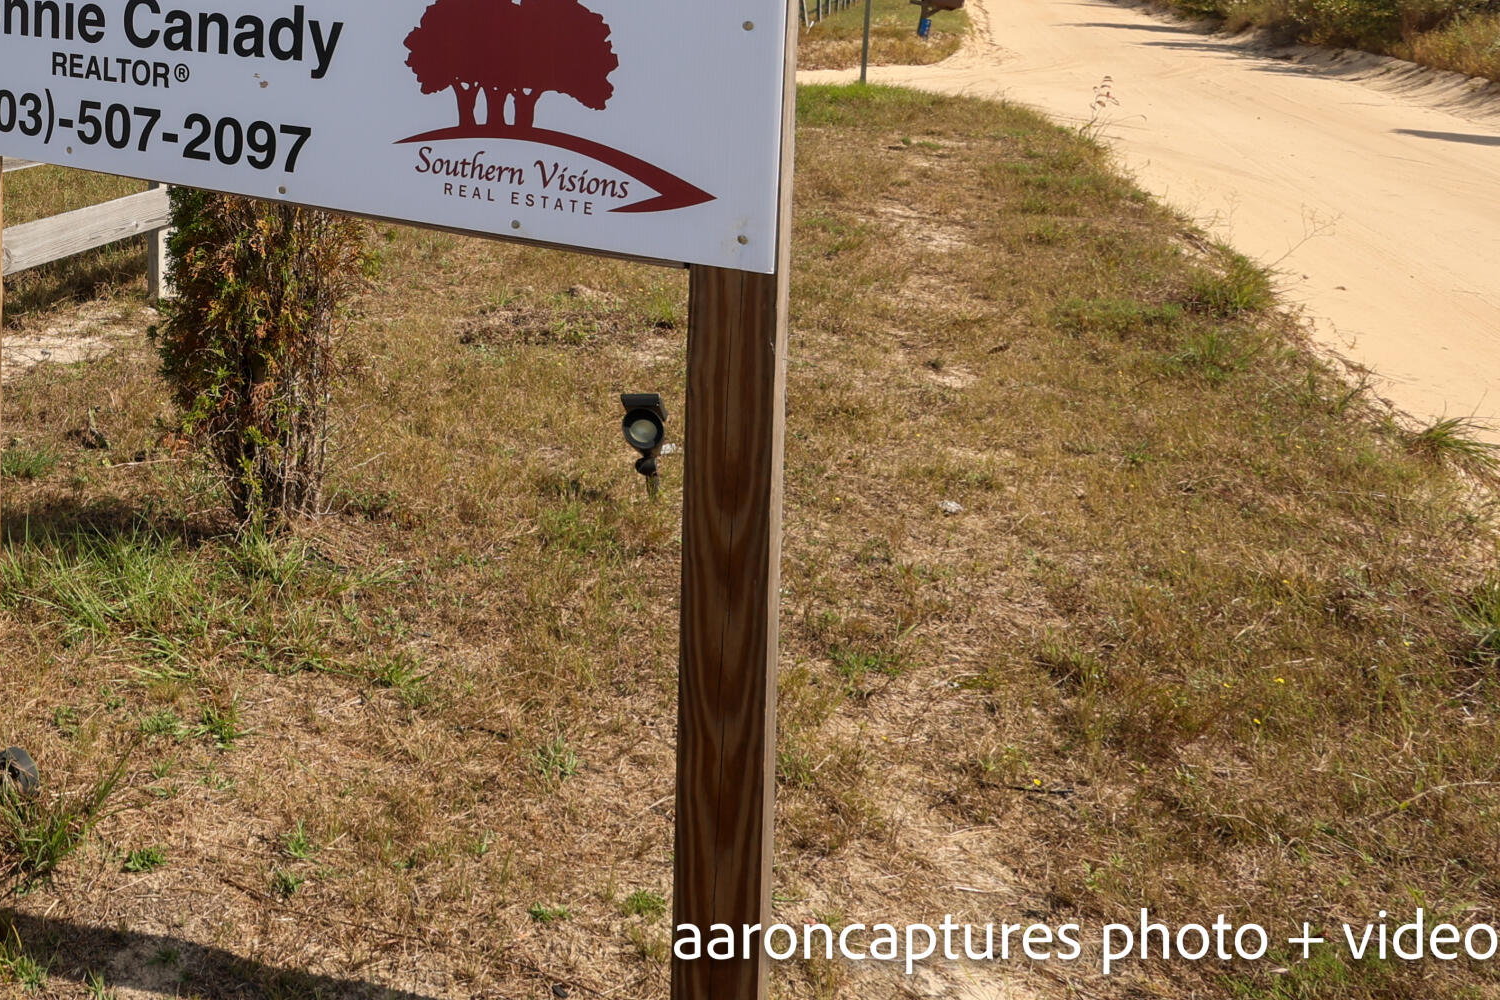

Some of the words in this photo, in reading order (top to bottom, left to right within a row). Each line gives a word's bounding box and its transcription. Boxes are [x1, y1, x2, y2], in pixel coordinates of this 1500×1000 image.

[414, 146, 525, 186] Southern
[533, 159, 630, 199] Visions
[443, 182, 495, 202] REAL
[510, 191, 593, 216] ESTATE
